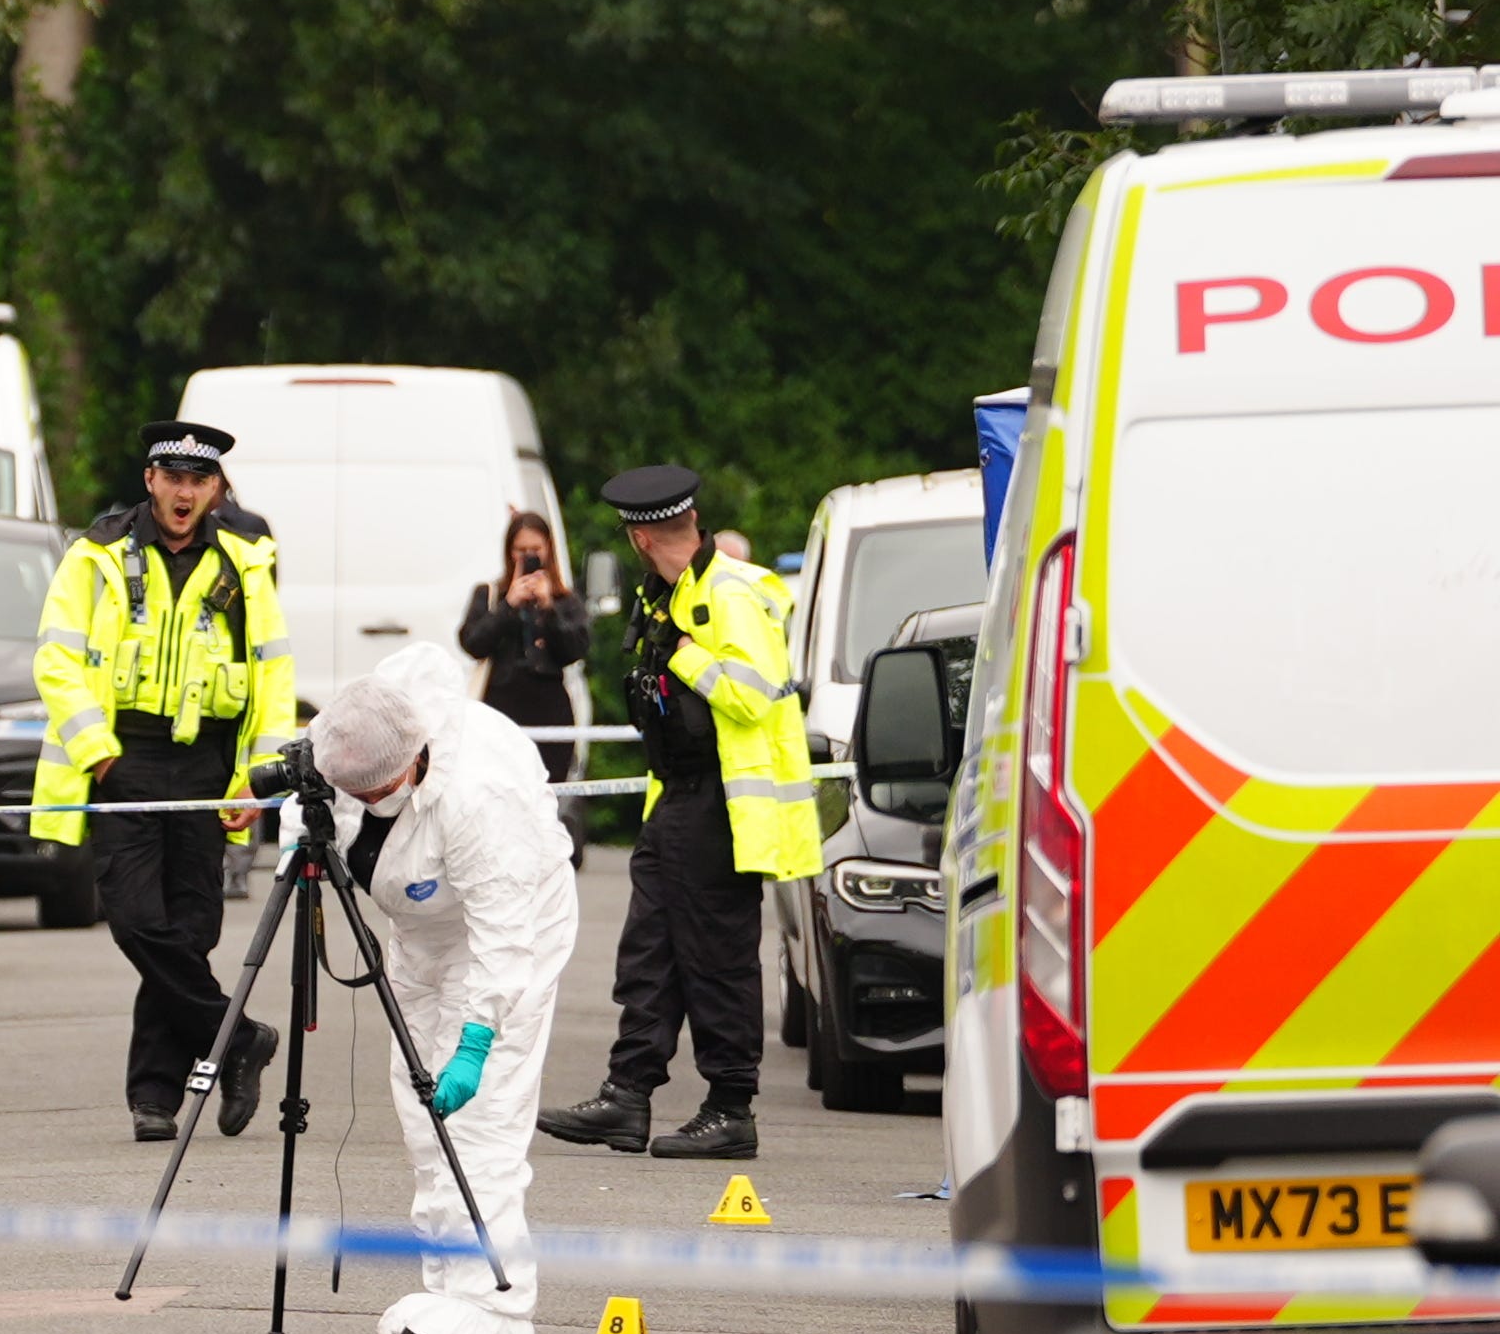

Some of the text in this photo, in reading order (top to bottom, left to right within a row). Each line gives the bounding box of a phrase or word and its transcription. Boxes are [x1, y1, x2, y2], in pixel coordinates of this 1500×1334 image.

[1175, 263, 1500, 355] PO
[741, 1195, 753, 1212] 6
[1209, 1184, 1360, 1241] MX73
[609, 1316, 624, 1334] 8
